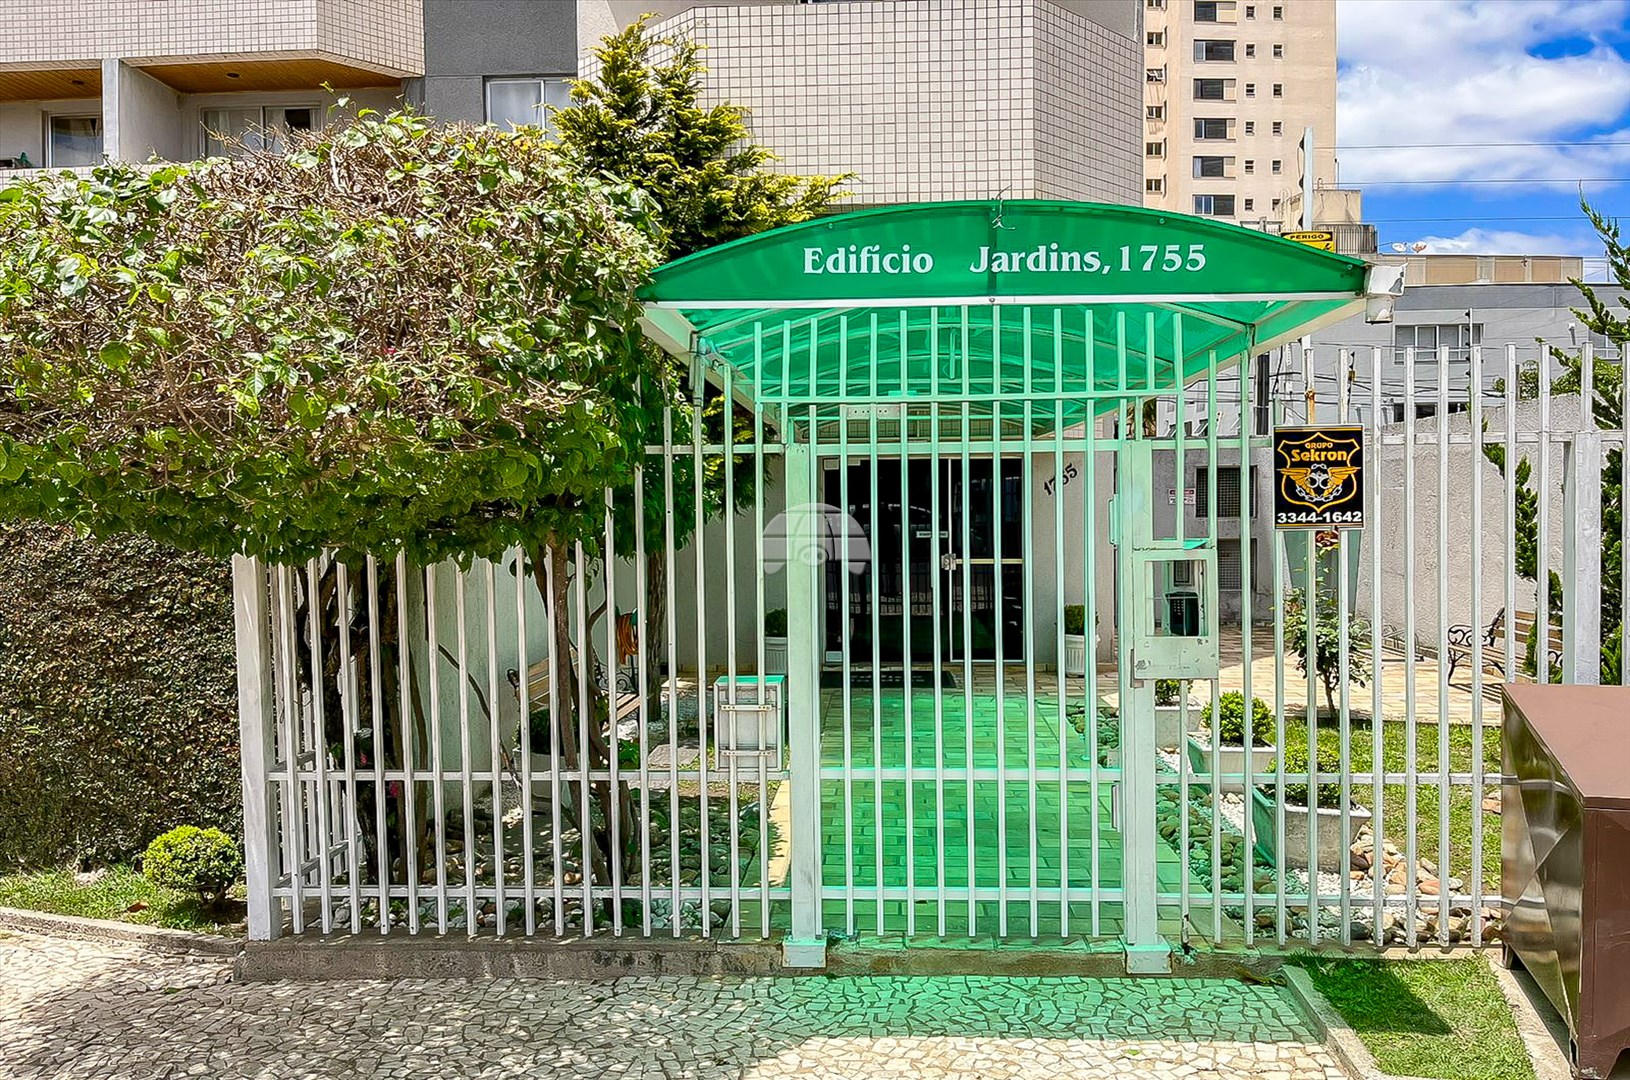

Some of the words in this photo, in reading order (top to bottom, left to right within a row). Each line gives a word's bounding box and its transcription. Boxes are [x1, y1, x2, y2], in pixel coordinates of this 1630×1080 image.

[803, 244, 934, 274] Edifício
[969, 242, 1110, 275] Jardins,
[1119, 244, 1207, 272] 1755
[1291, 449, 1348, 462] Sekron
[1277, 511, 1362, 523] 3344-1642
